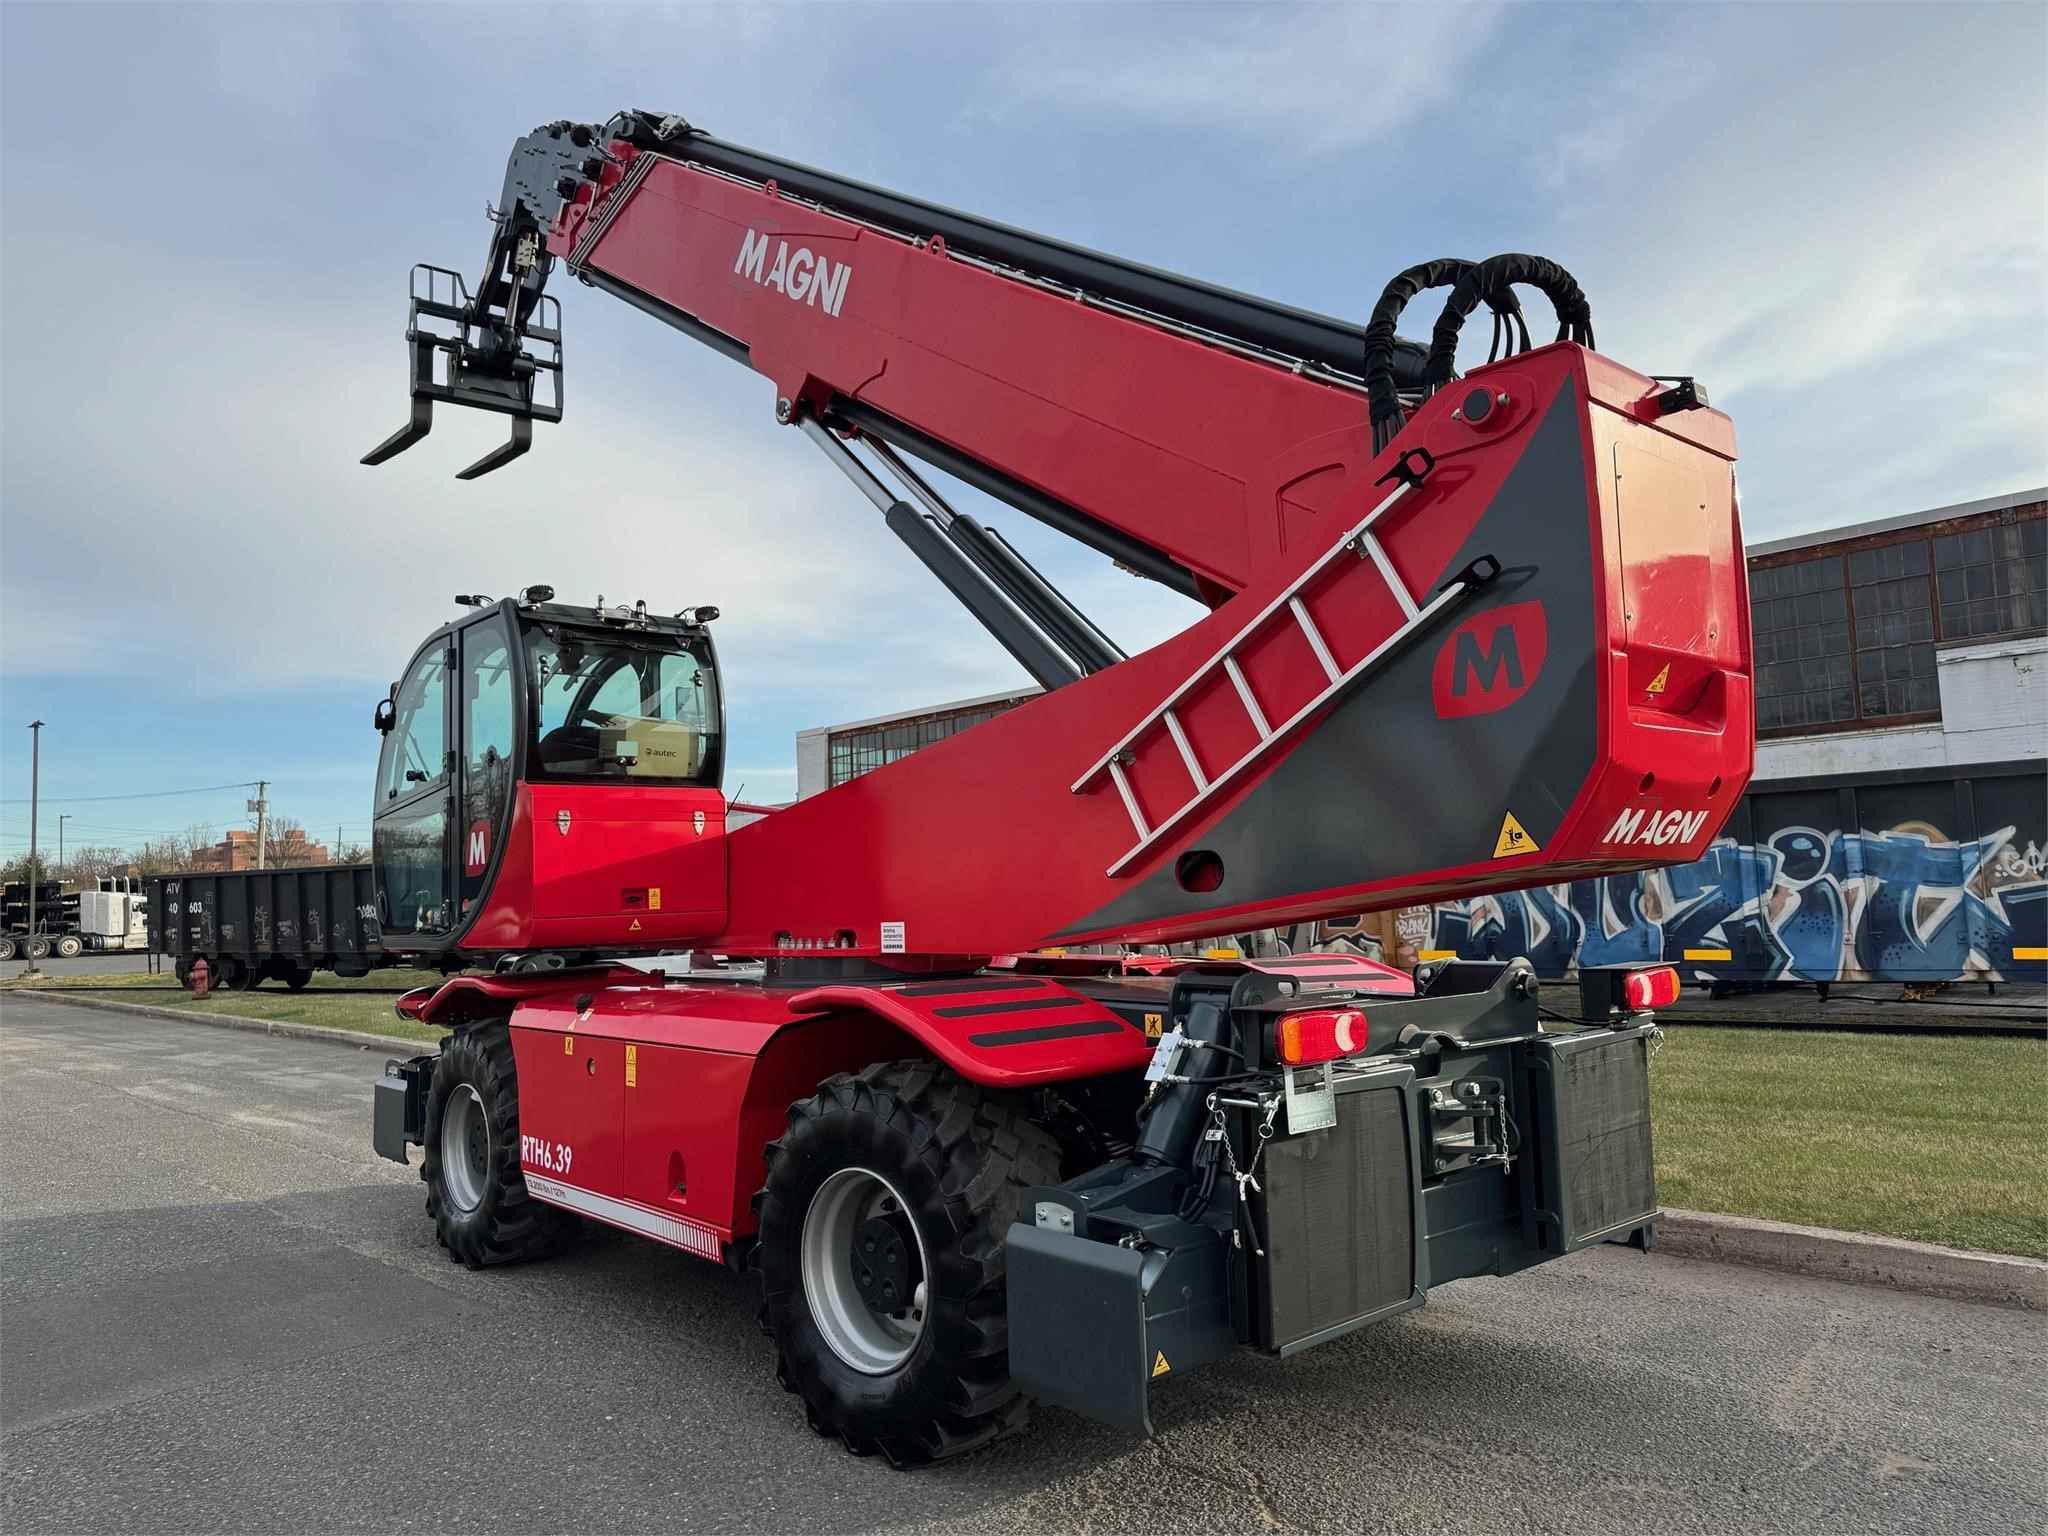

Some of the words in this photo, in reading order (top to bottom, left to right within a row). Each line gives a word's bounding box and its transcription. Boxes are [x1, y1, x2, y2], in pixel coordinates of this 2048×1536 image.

[734, 228, 852, 318] MAGNI
[1452, 624, 1526, 697] M
[653, 749, 677, 758] autec
[1602, 807, 1709, 846] MAGNI
[469, 831, 486, 866] M
[188, 902, 203, 913] 603
[521, 1134, 573, 1175] RTH6.39
